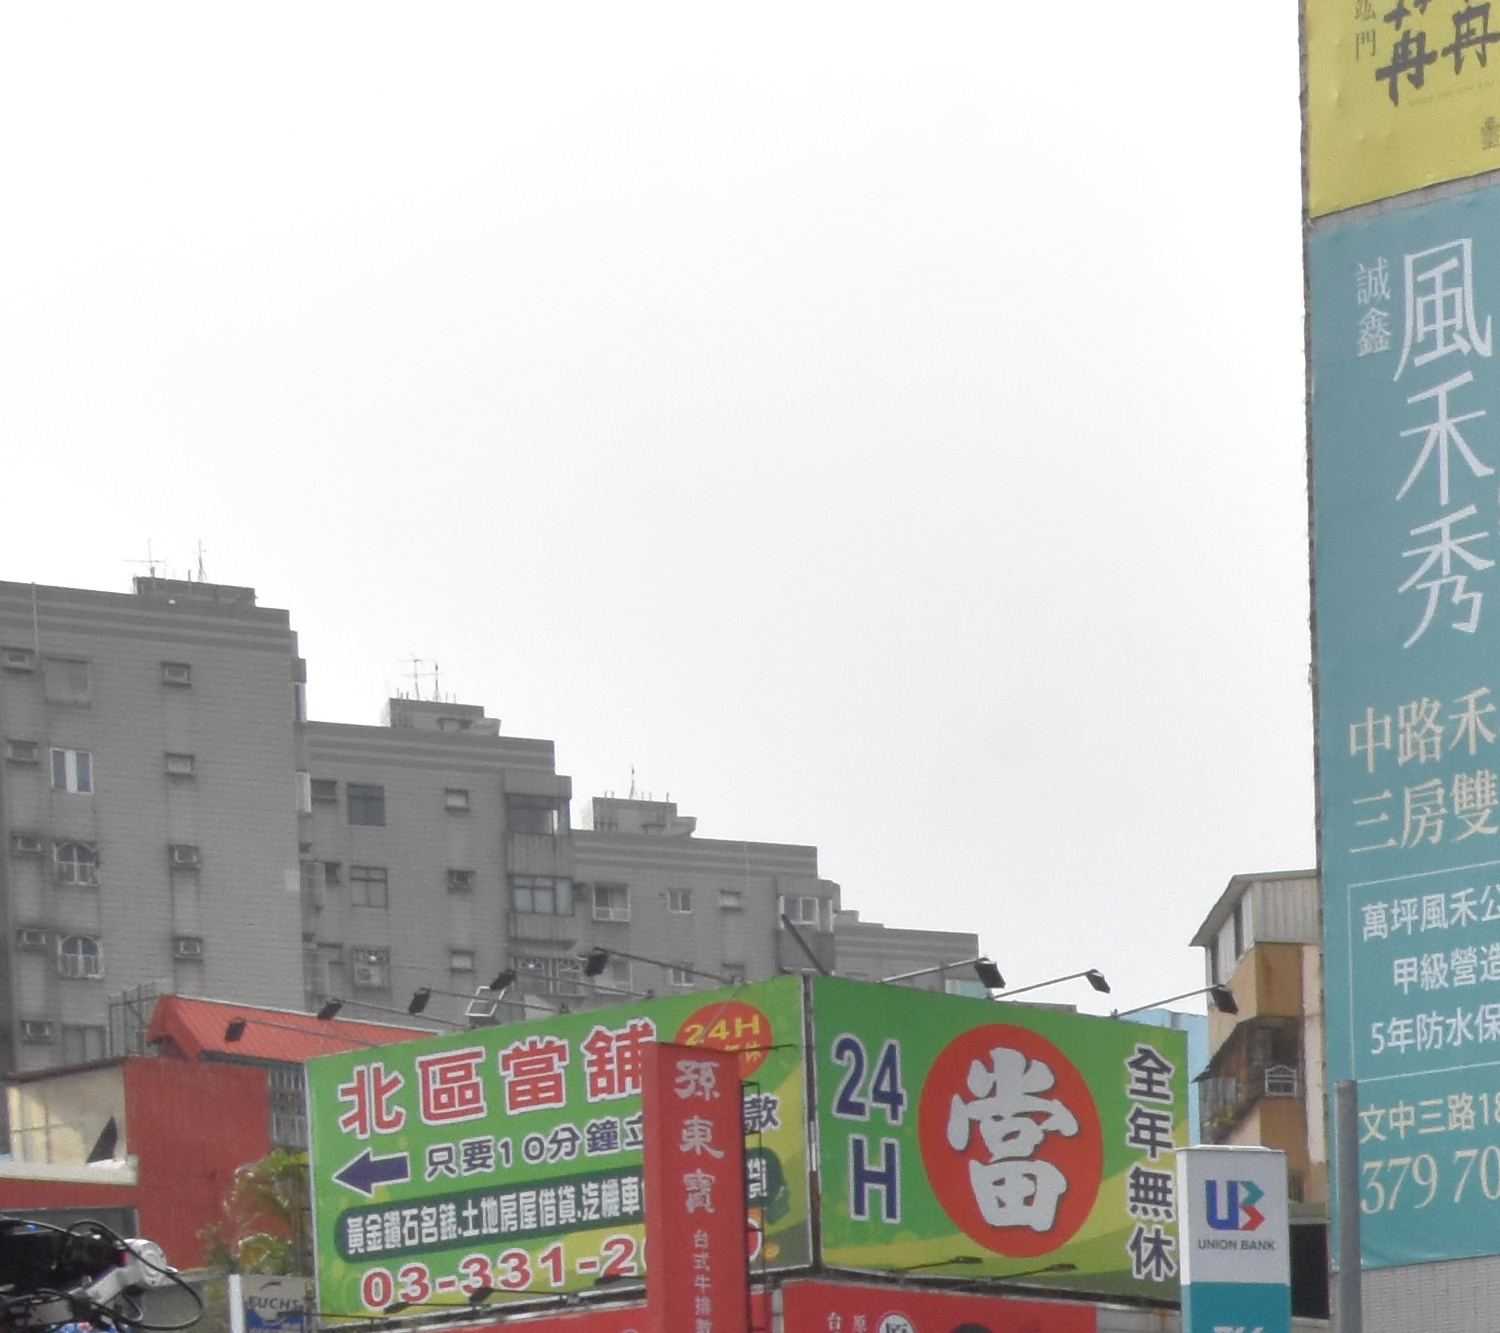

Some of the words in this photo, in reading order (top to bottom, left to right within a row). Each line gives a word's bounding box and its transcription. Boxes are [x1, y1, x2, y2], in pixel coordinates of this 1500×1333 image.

[1394, 237, 1494, 651] 風禾秀
[830, 1031, 908, 1125] 24
[849, 1132, 901, 1225] H
[946, 1045, 1080, 1233] 當
[1124, 1042, 1180, 1282] 全年無休
[1360, 1153, 1439, 1214] 379
[361, 1233, 646, 1312] 03-331-2
[1197, 1238, 1238, 1251] UNION
[1240, 1238, 1276, 1252] BANK
